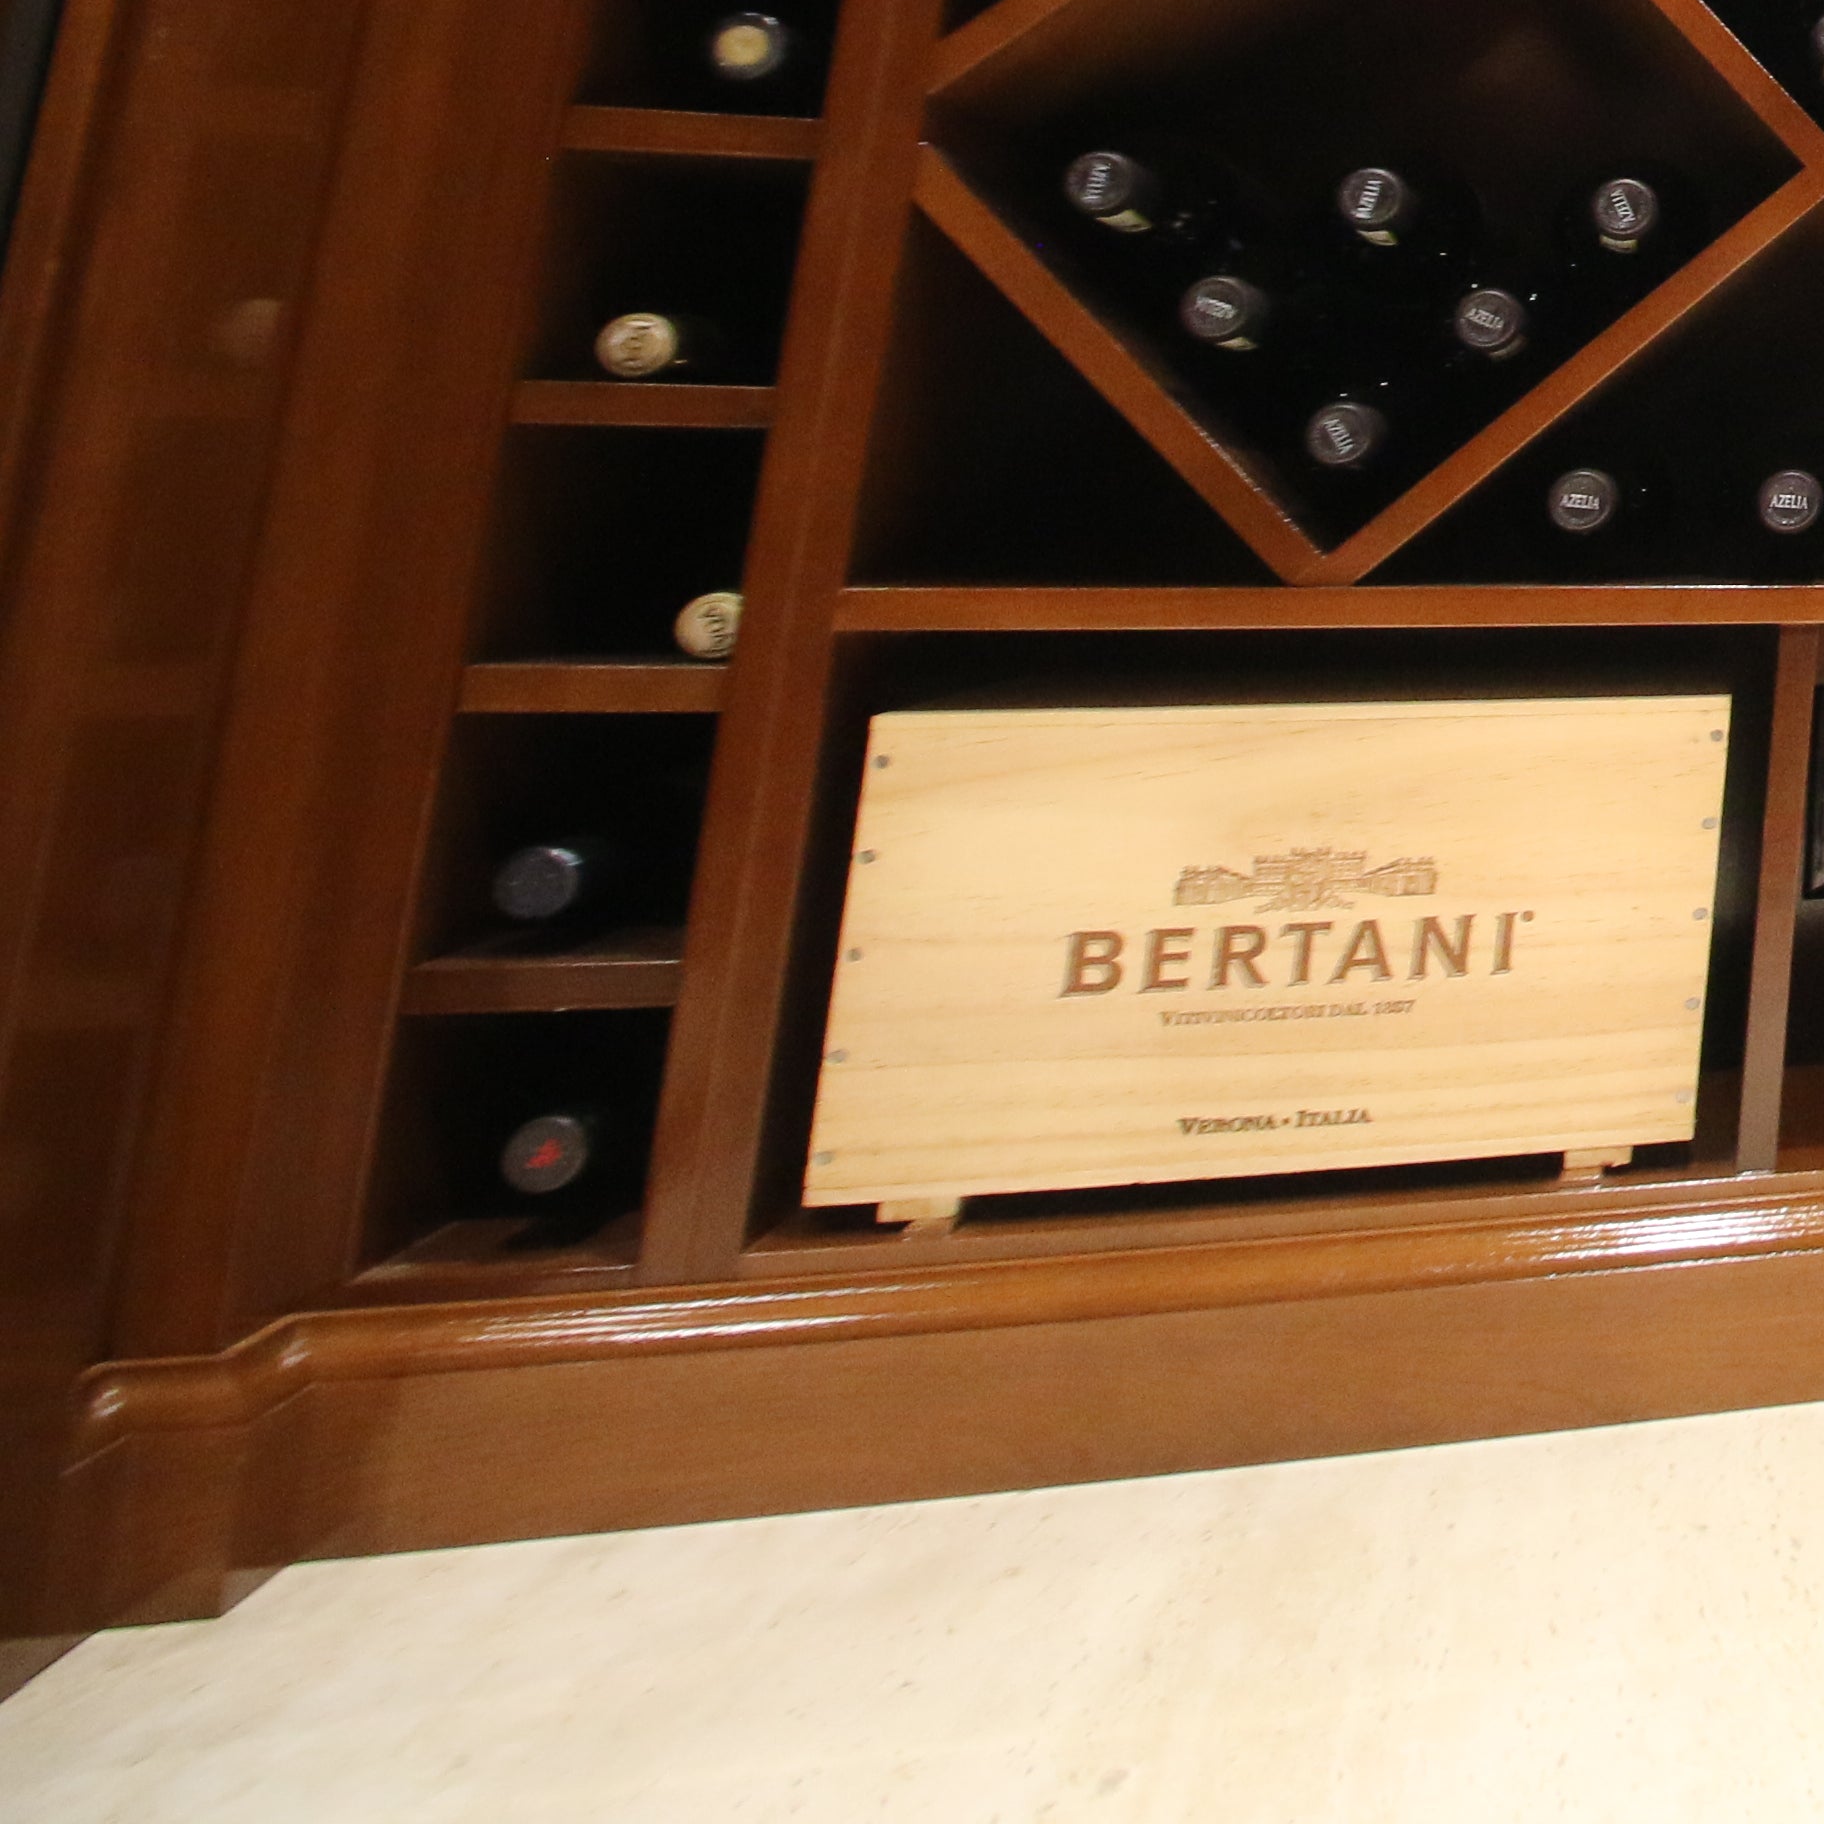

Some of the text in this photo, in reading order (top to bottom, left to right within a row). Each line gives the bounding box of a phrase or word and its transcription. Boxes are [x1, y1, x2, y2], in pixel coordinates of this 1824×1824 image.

[1769, 494, 1809, 510] AZELIA
[1058, 911, 1518, 999] BERTANI
[1177, 1108, 1373, 1136] VERONA ITALIA
